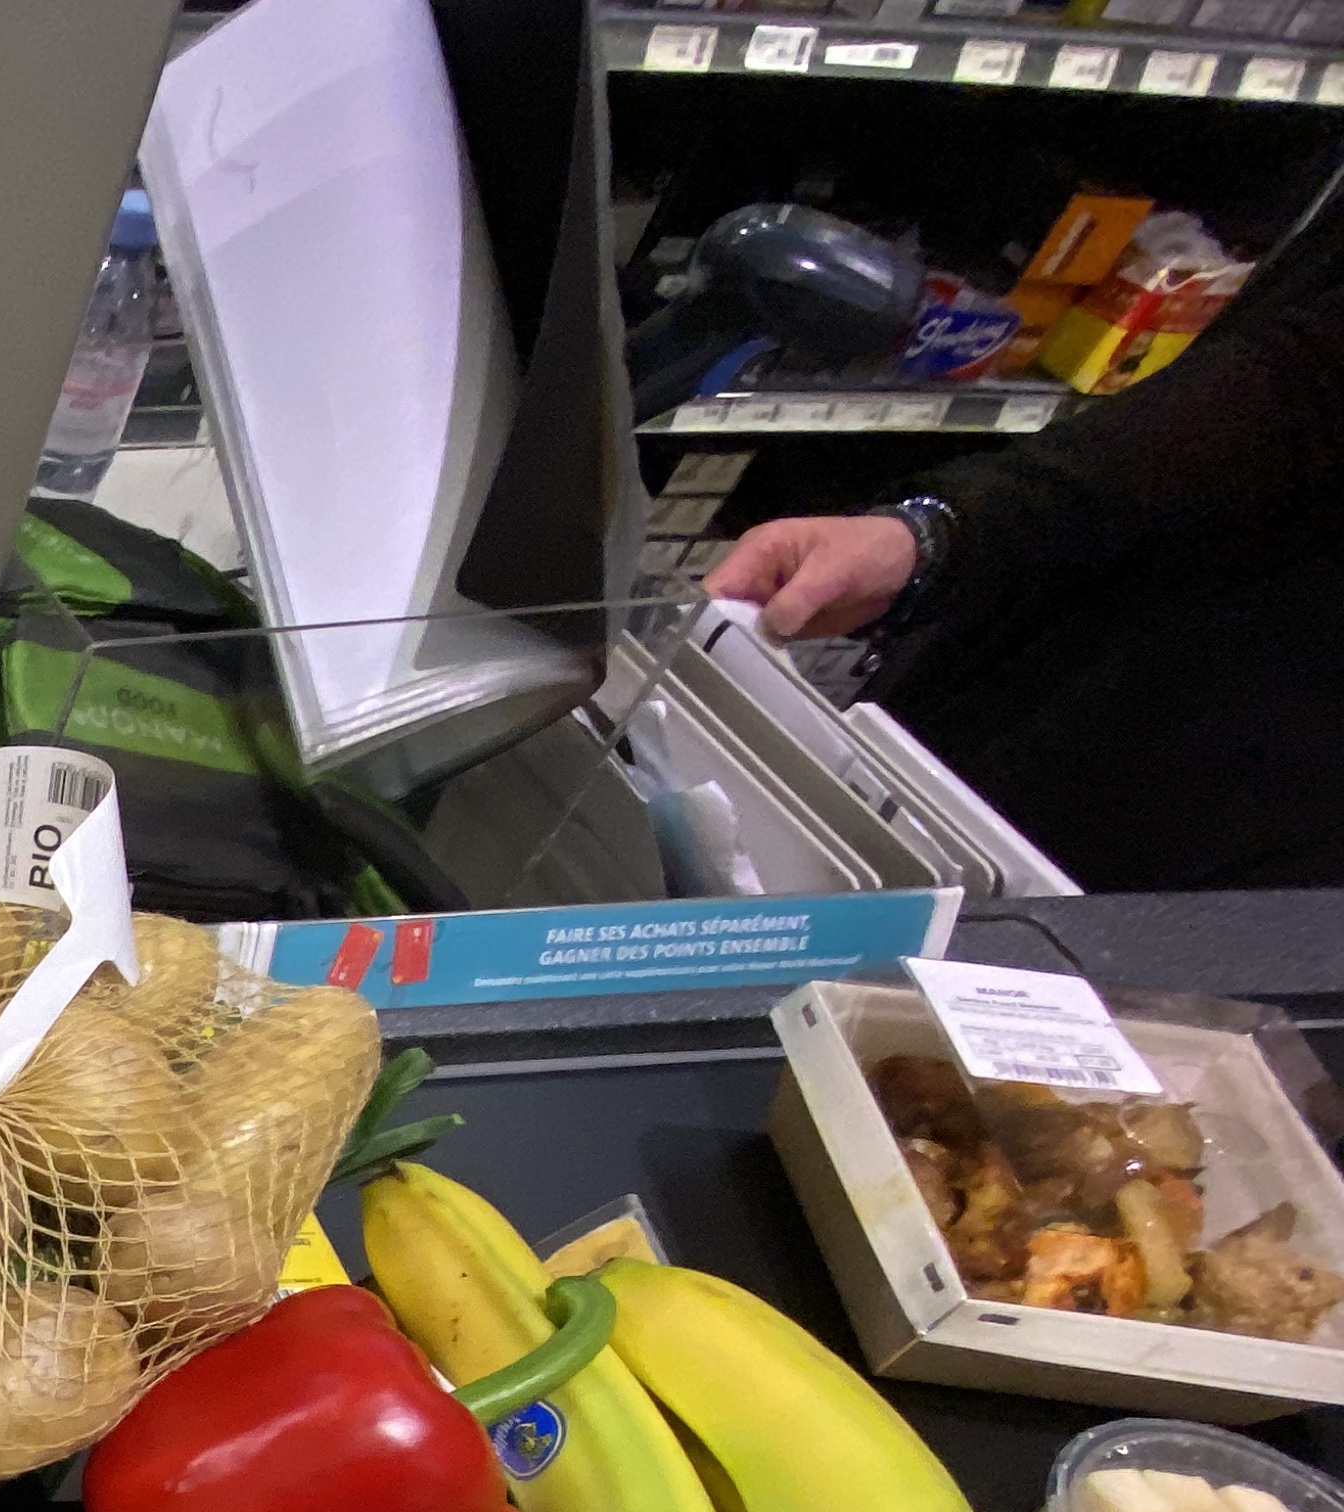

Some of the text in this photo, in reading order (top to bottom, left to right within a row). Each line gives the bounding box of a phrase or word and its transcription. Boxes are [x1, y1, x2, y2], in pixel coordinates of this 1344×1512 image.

[27, 824, 64, 892] BIO
[546, 926, 595, 945] FAIRE
[598, 924, 626, 942] SES
[629, 921, 697, 940] ACHATS
[538, 936, 810, 966] GAGNER DES POINTS ENSEMBLE
